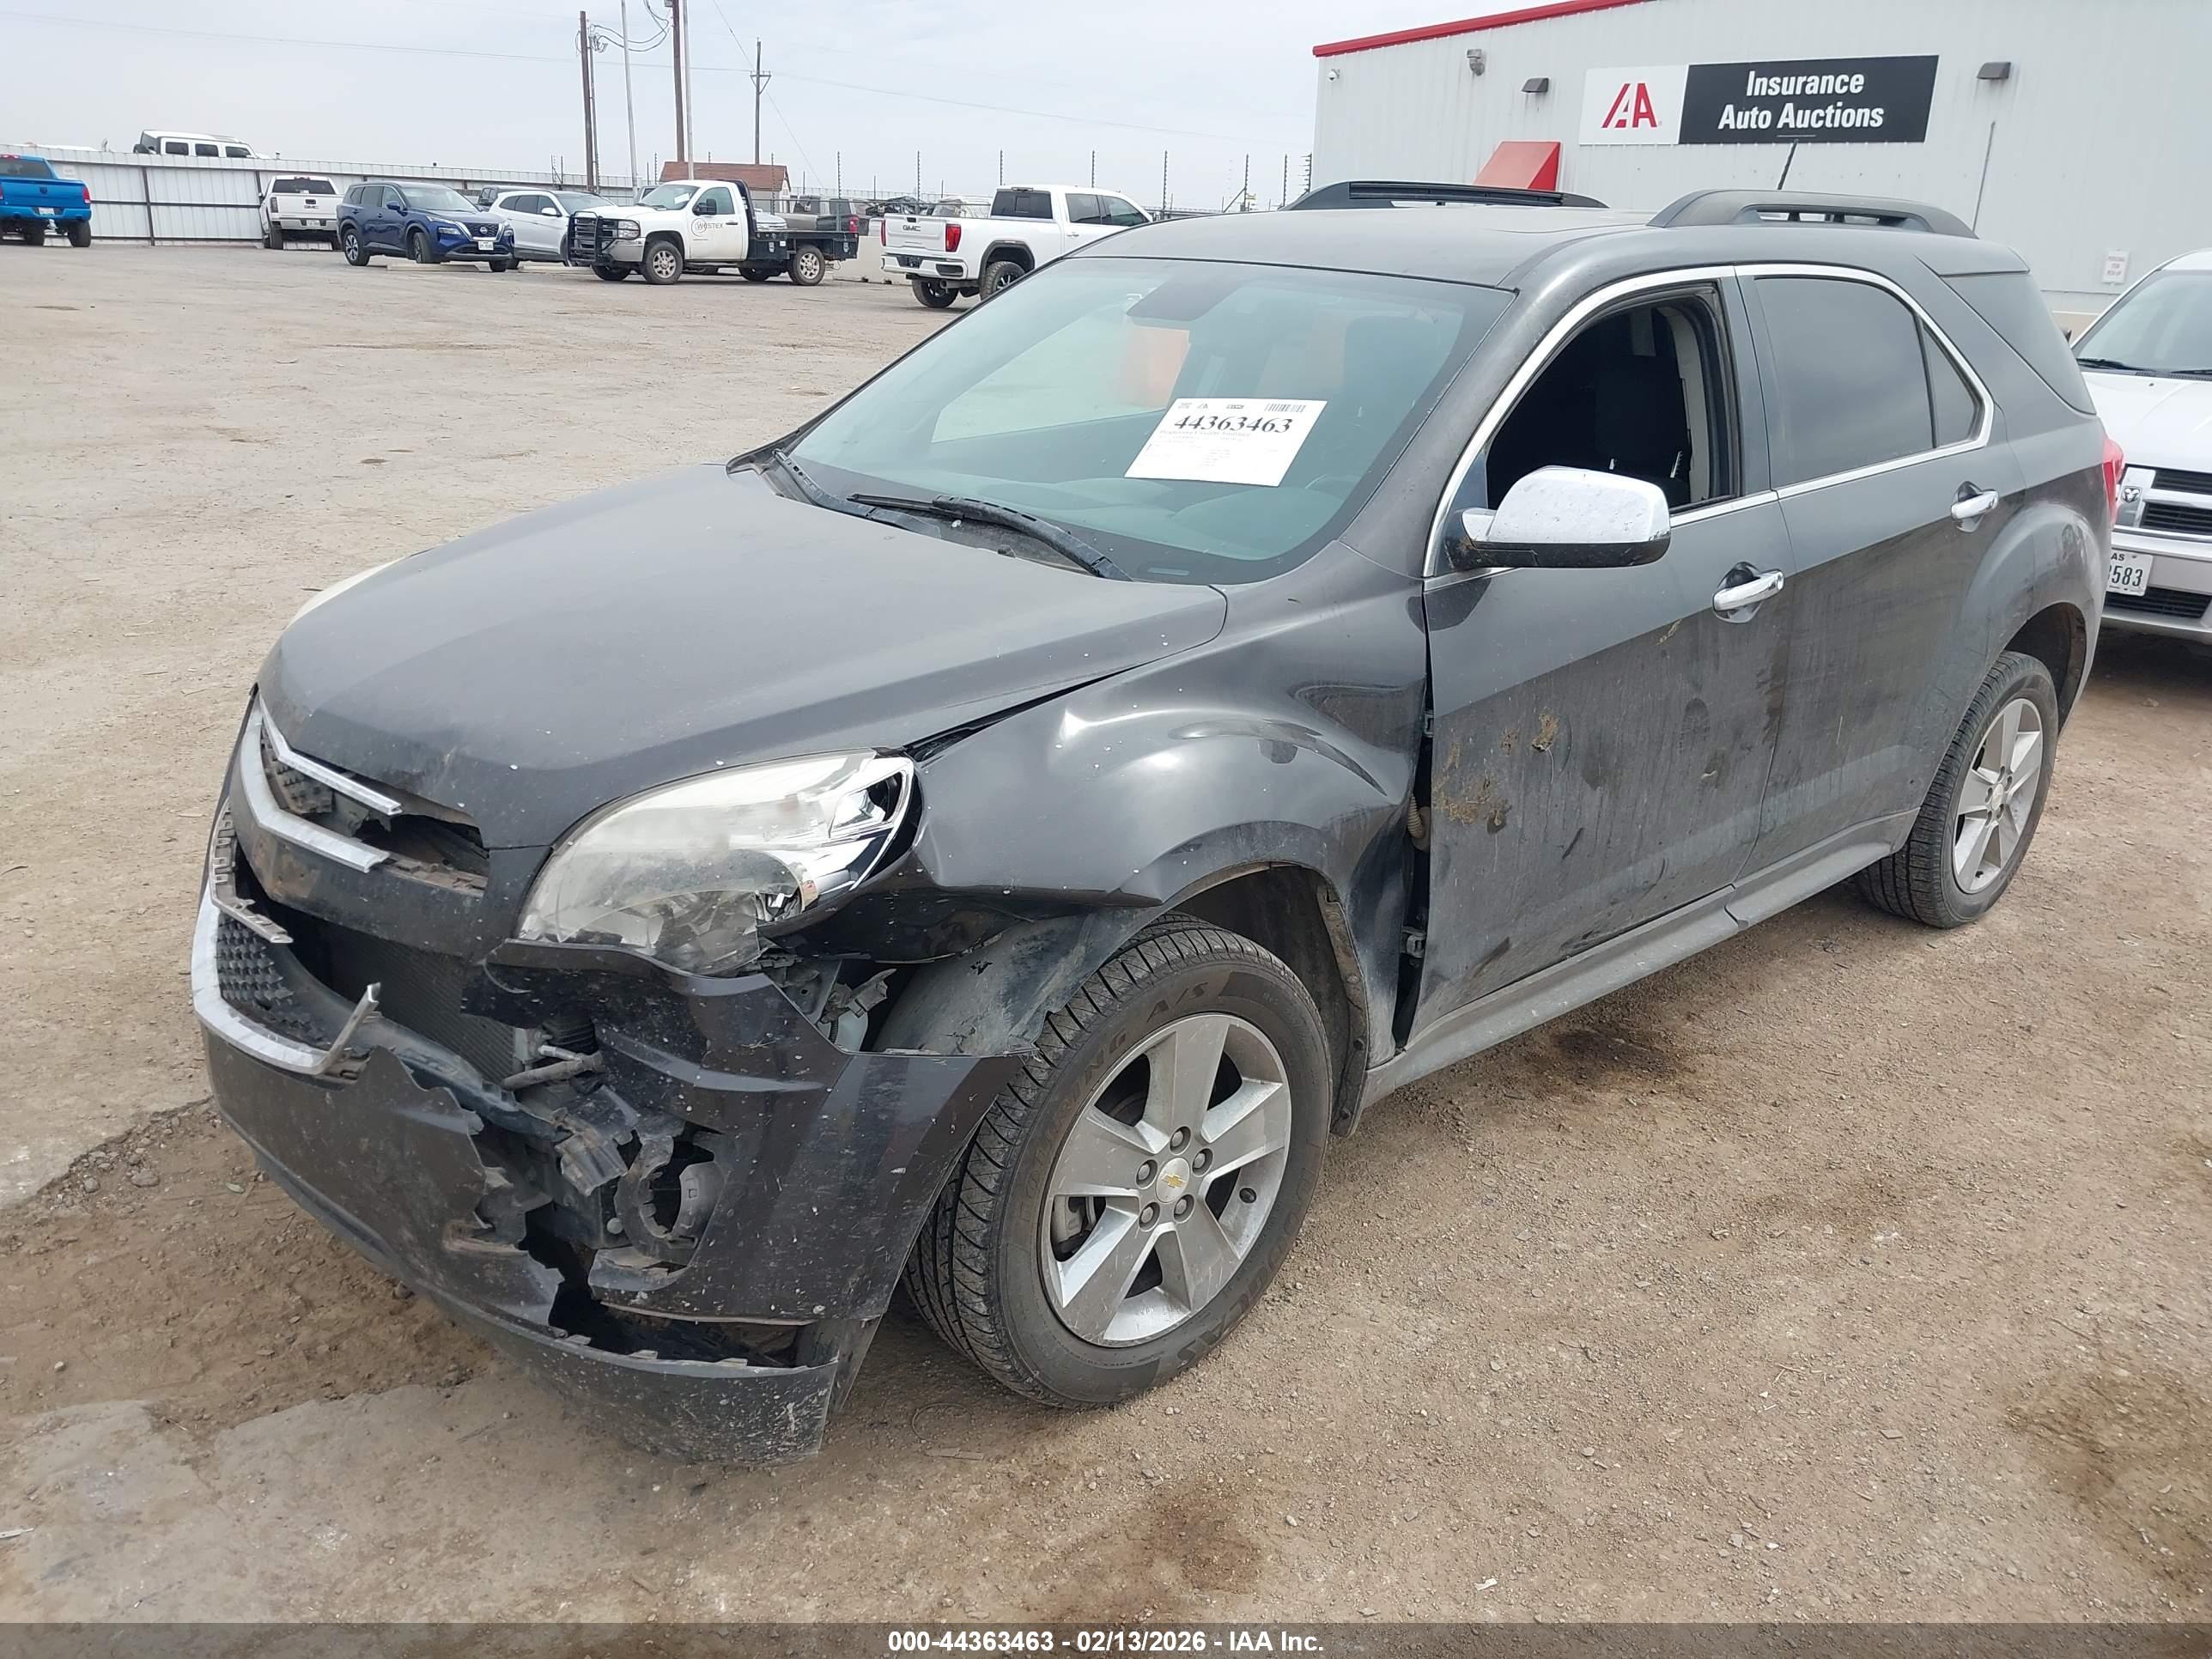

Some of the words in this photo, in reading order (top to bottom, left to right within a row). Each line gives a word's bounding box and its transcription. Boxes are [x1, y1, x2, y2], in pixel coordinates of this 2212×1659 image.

[1746, 70, 1865, 96] Insurance
[1717, 104, 1772, 130] Auto
[1776, 101, 1885, 129] Auctions
[1174, 415, 1293, 433] 44363463
[2108, 564, 2143, 586] 583
